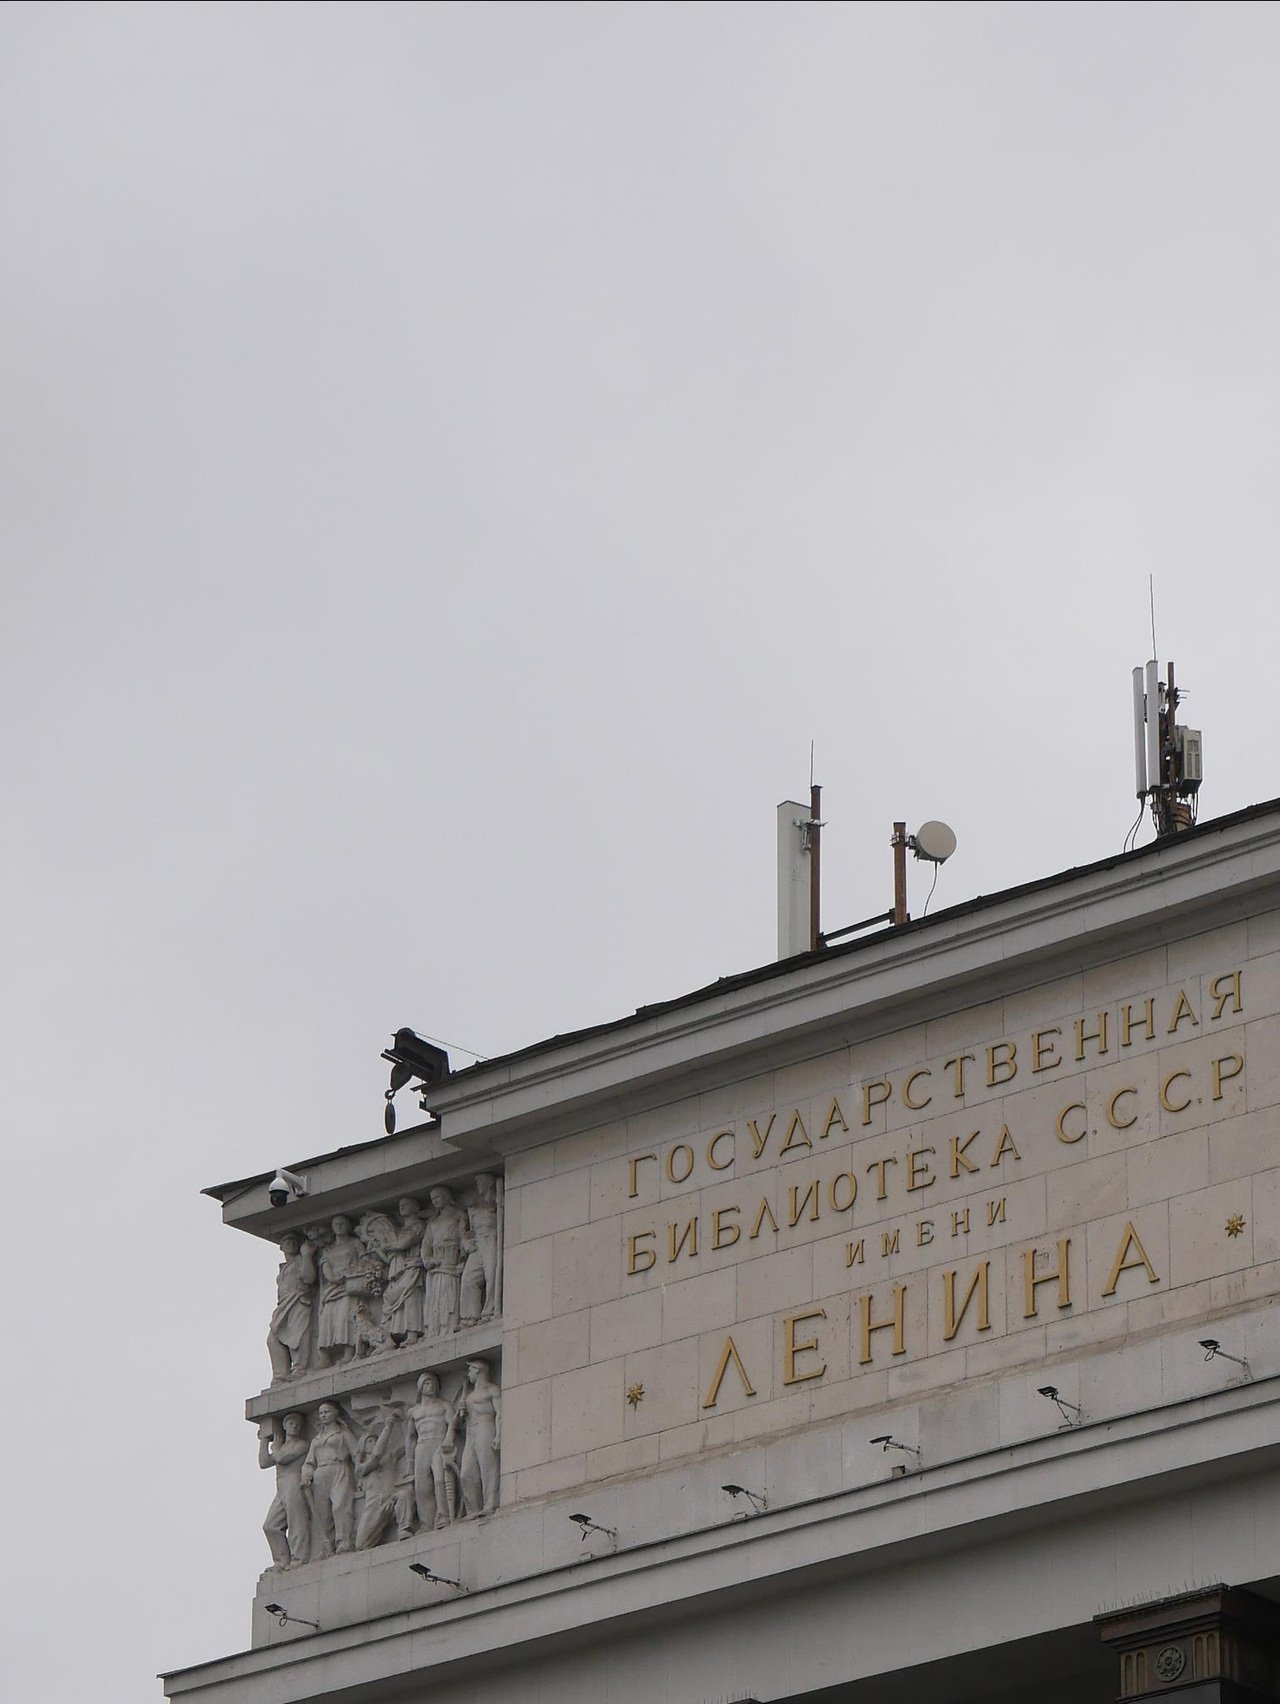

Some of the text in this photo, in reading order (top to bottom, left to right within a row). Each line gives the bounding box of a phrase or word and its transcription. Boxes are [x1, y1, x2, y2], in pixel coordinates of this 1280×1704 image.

[626, 969, 1244, 1198] ГОСУДАРСТВЕННАЯ
[626, 1053, 1245, 1276] БИБЛИОТЕКА СССР
[702, 1221, 1160, 1409] ЛЕНИНА
[844, 1198, 1007, 1268] ИМЕНИ
